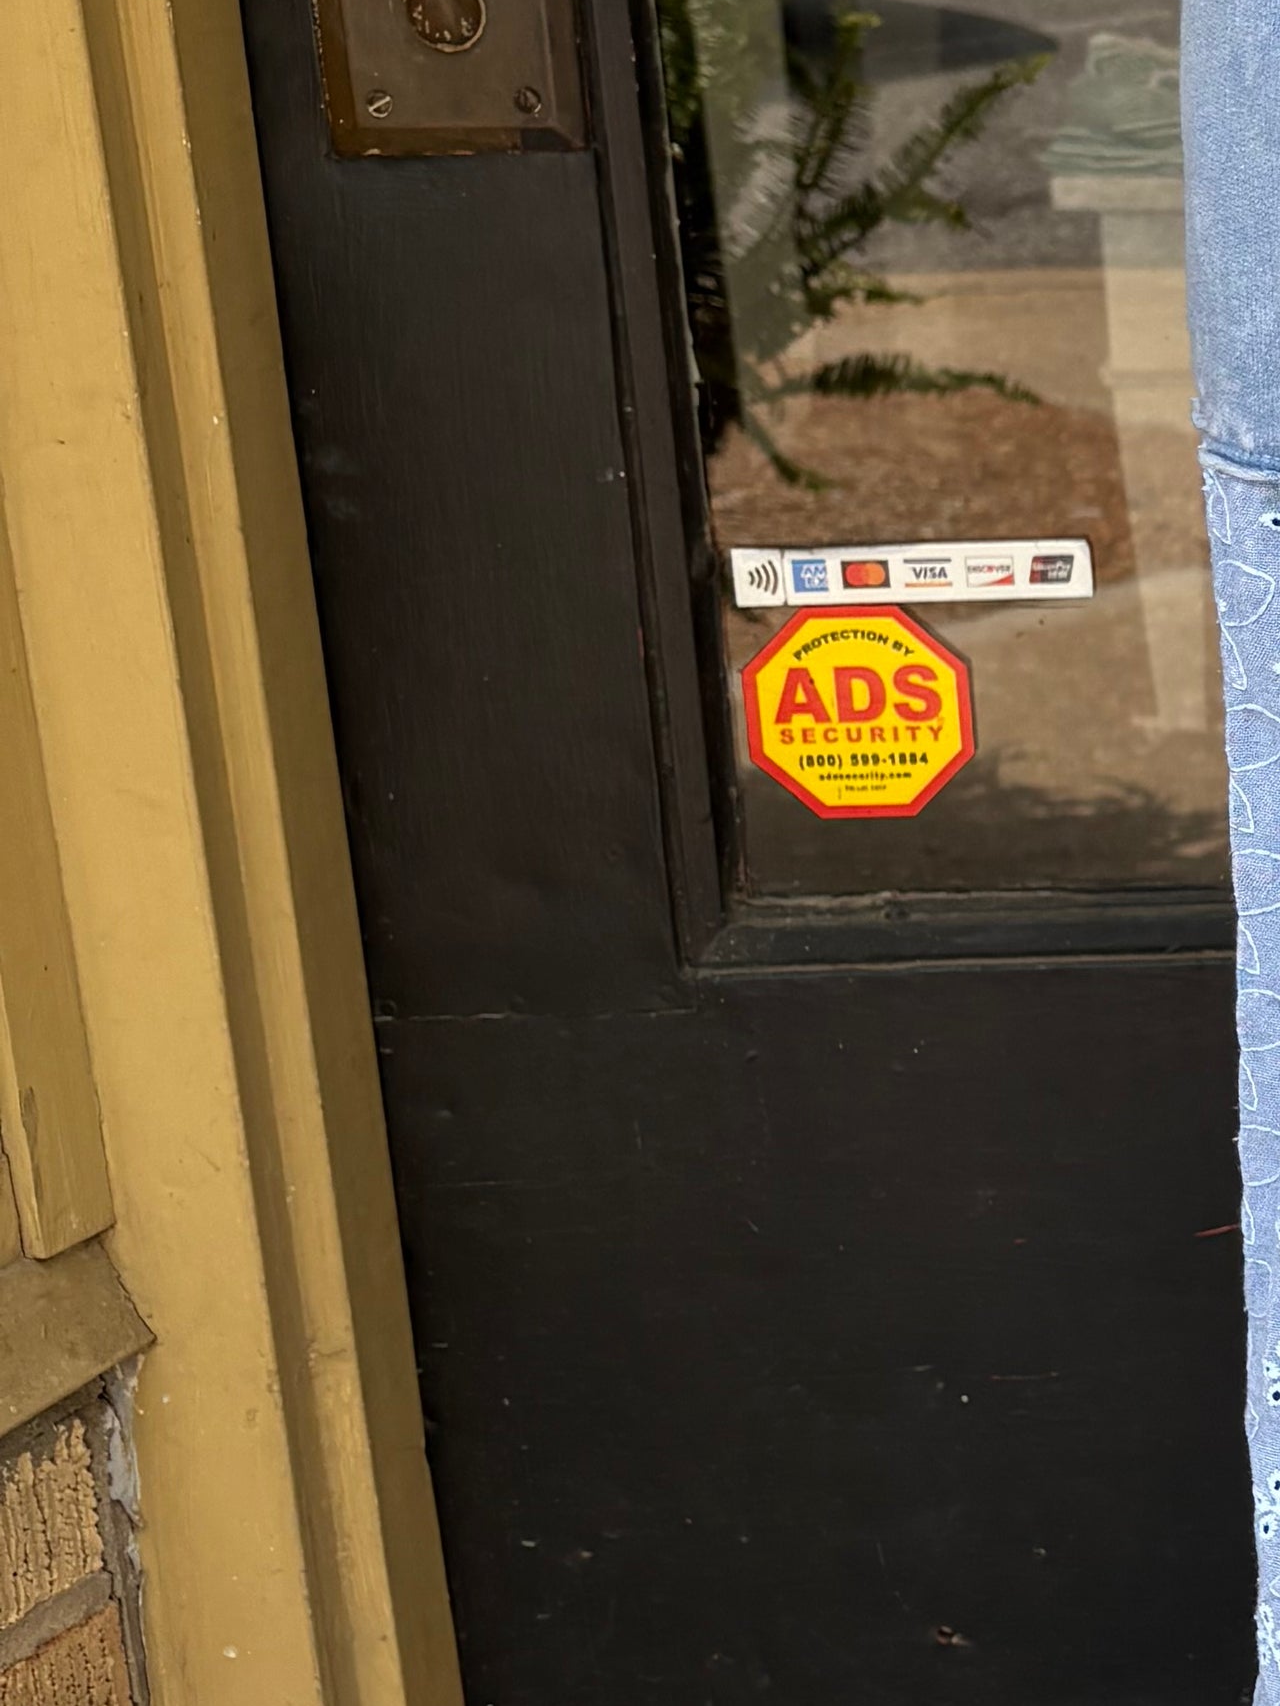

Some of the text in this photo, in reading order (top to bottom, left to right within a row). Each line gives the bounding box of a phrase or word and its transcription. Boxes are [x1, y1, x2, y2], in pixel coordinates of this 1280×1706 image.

[911, 566, 948, 580] VISA
[793, 629, 914, 661] PROTECTION BY
[774, 664, 943, 725] ADS
[780, 726, 943, 744] SECURITY
[799, 753, 843, 771] (800)
